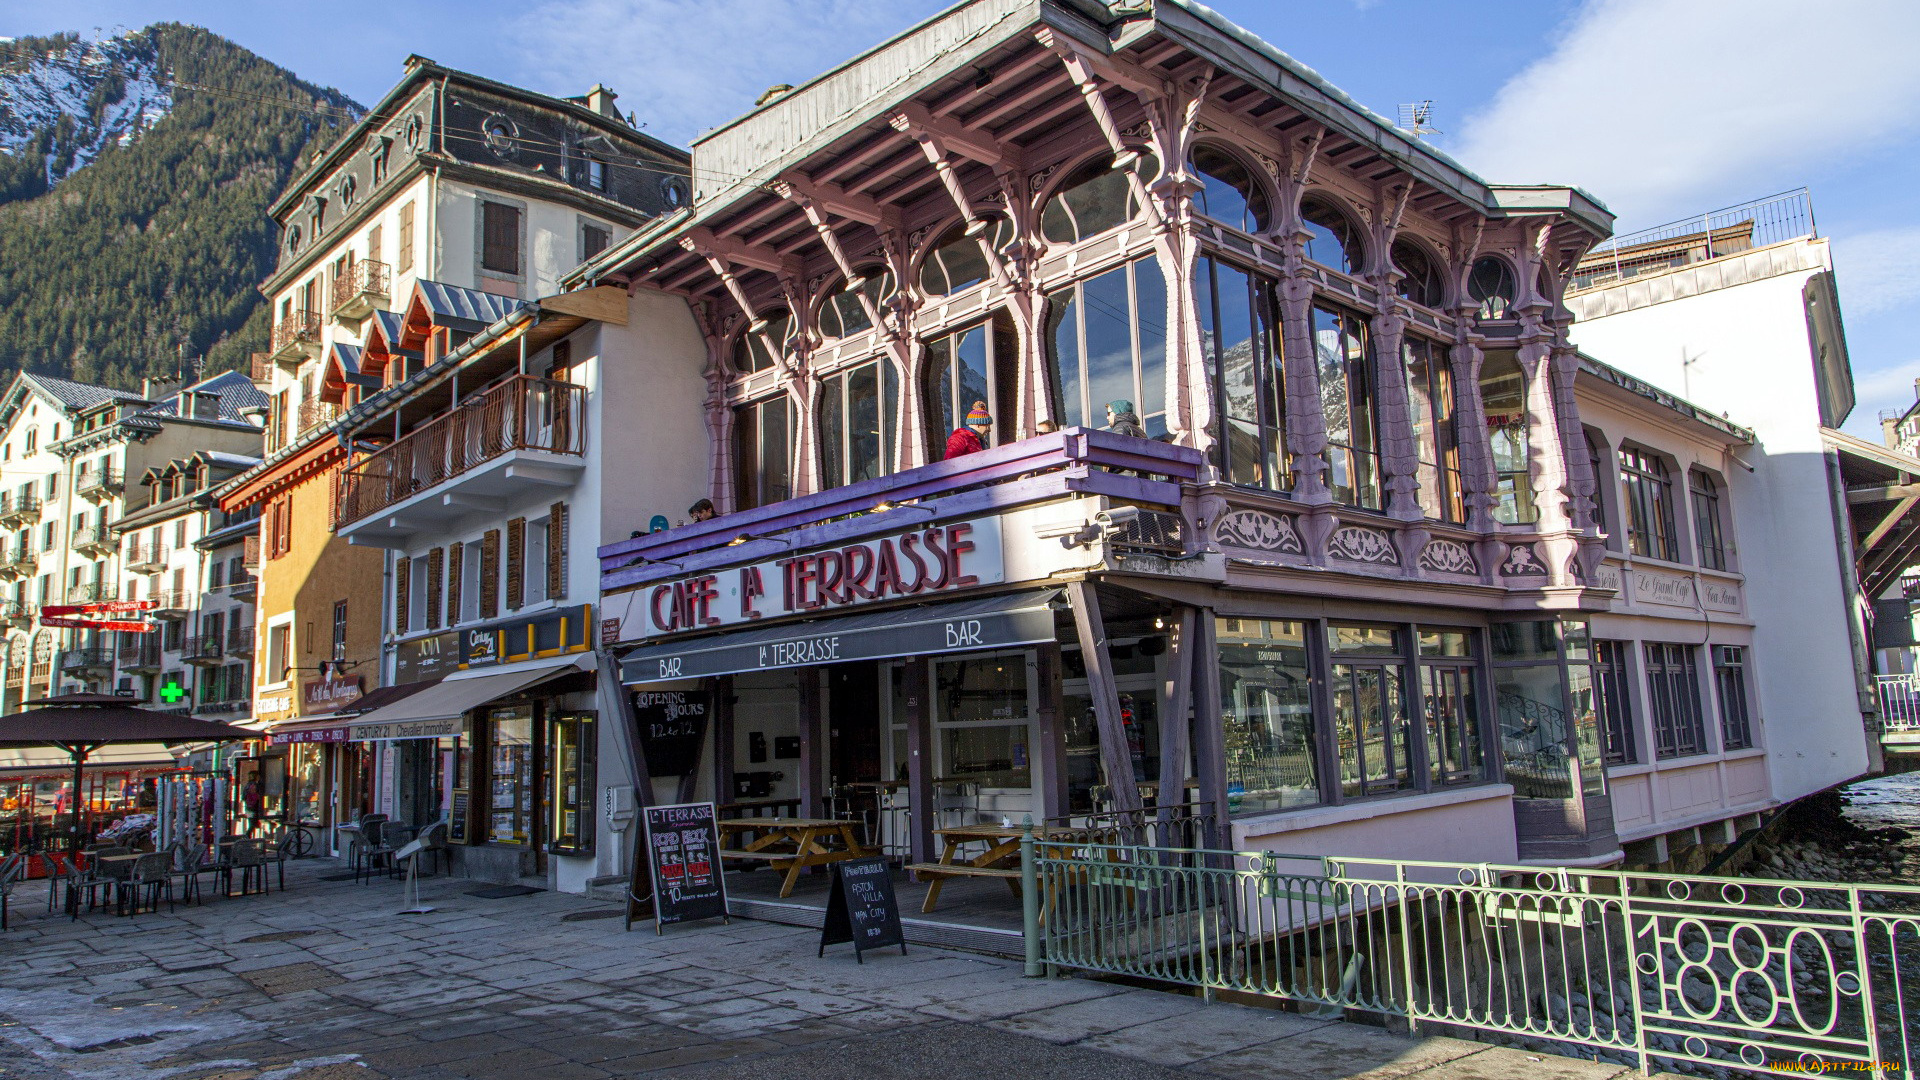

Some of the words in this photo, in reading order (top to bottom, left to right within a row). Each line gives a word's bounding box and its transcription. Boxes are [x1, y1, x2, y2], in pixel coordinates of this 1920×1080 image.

[650, 575, 721, 631] CAFE
[740, 566, 764, 618] LA
[776, 523, 977, 612] TERRASSE
[110, 600, 141, 611] CHAMONIX
[945, 620, 983, 647] BAR
[759, 646, 767, 666] LA
[772, 637, 840, 665] TERRASSE
[659, 657, 682, 678] BAR
[637, 691, 686, 708] OPENING
[664, 703, 705, 721] HOURS
[356, 725, 383, 739] CENTURY
[659, 806, 713, 822] TERRASSE
[852, 880, 874, 896] ASTON
[862, 891, 885, 902] VILLA
[870, 907, 886, 921] CITY
[1637, 916, 1839, 1035] 1880
